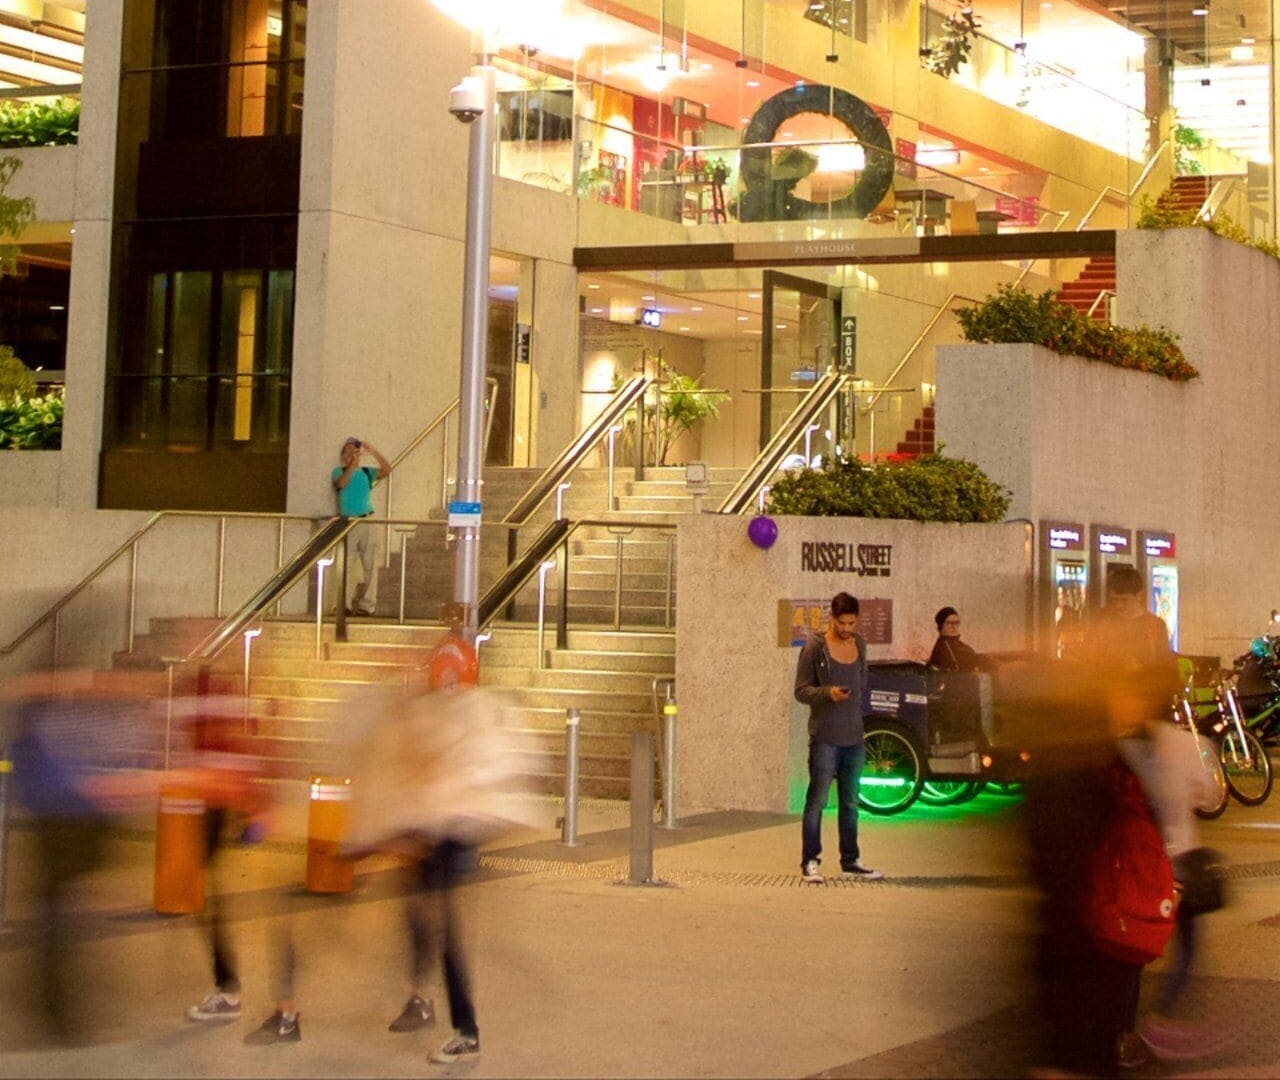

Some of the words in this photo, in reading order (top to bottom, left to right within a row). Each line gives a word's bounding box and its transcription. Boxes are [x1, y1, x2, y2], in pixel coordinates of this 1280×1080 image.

[794, 243, 857, 254] PLAYHOUSE
[844, 336, 853, 367] BOX
[801, 541, 857, 573] RUSSELL
[857, 543, 892, 577] STREET
